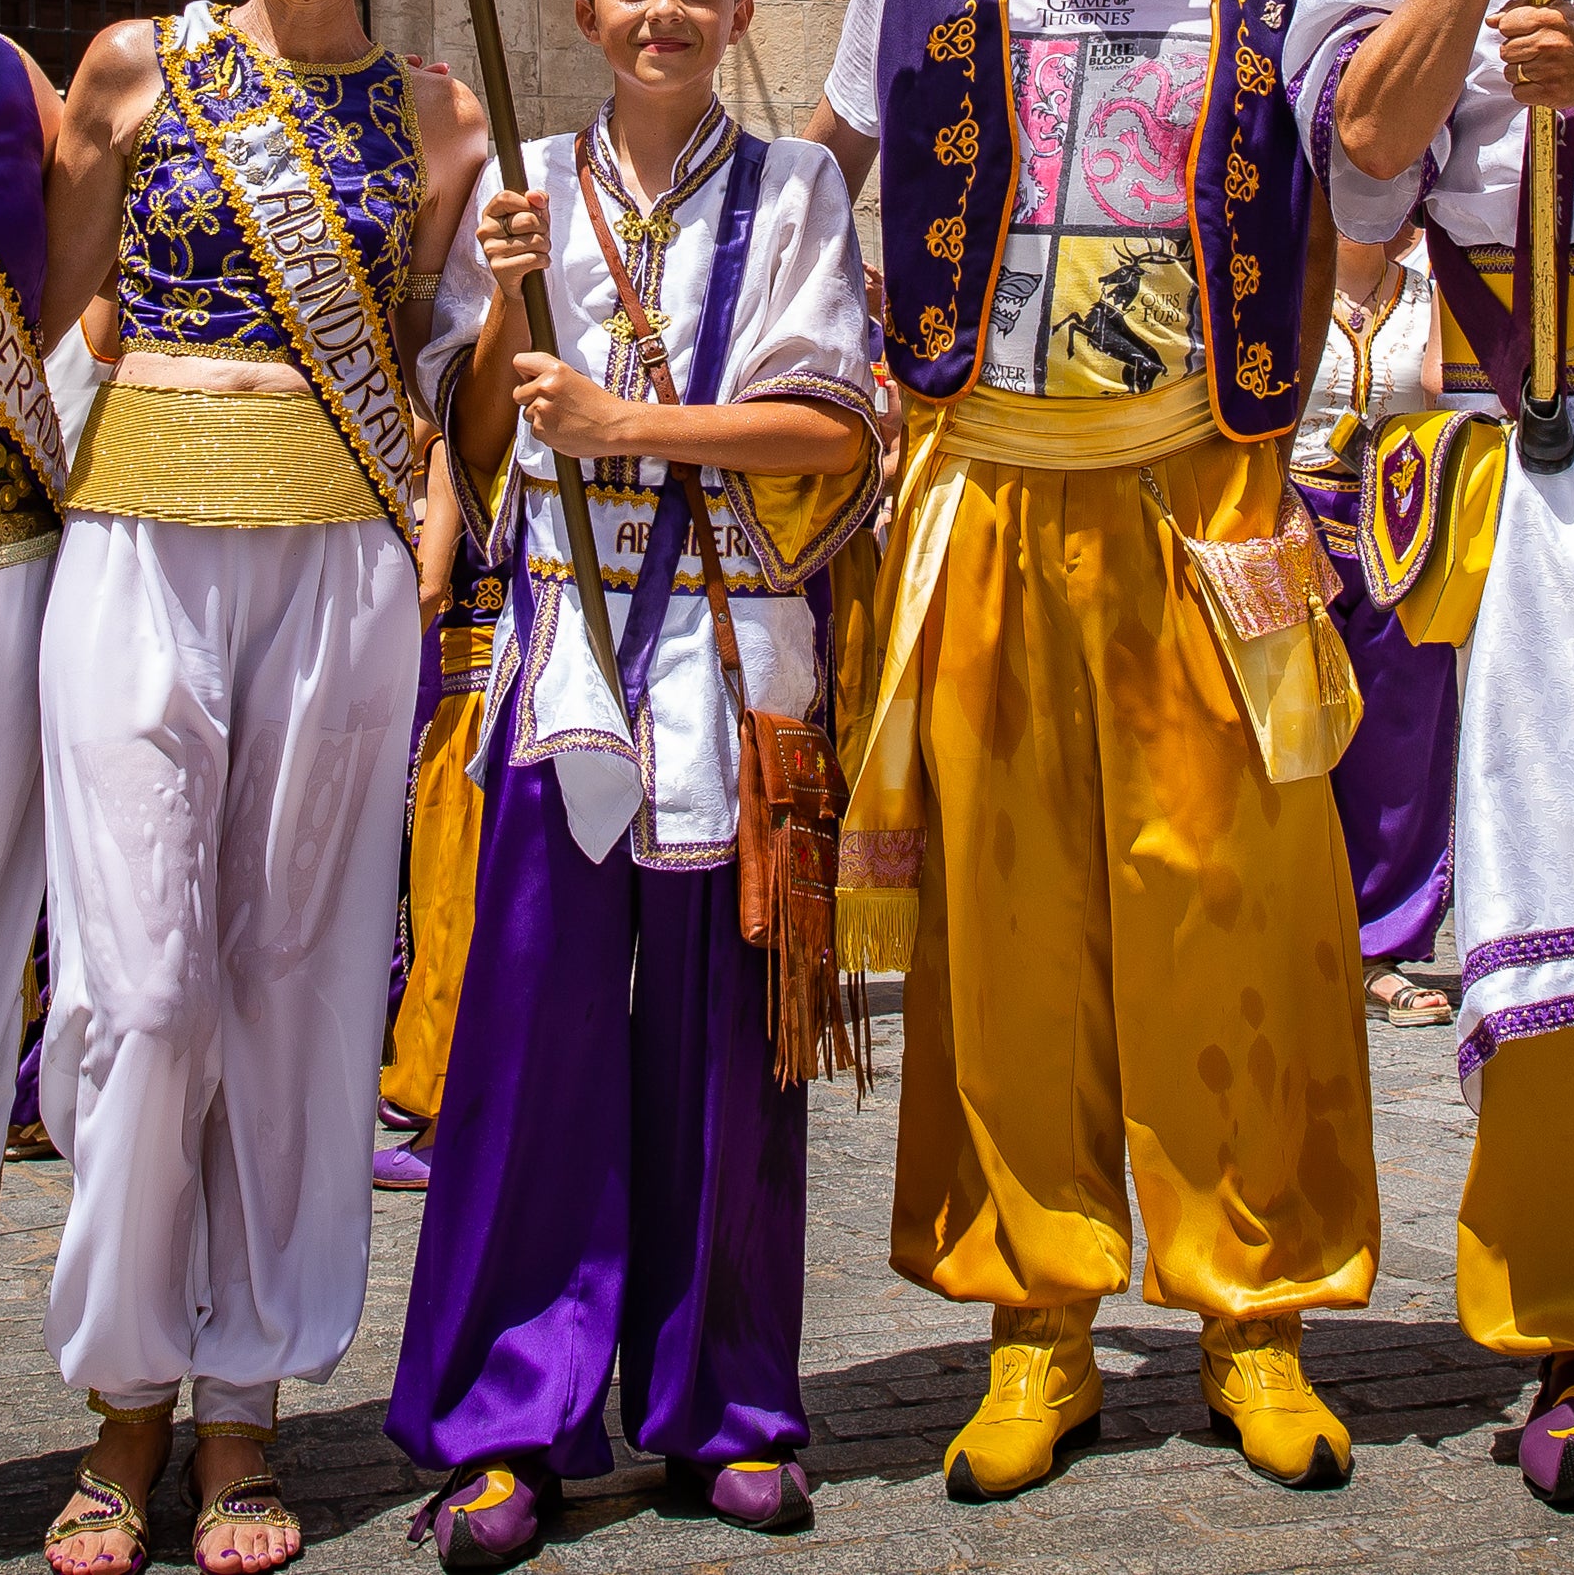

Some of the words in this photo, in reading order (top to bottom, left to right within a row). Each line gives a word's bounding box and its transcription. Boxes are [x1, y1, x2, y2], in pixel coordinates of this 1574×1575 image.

[1037, 8, 1131, 28] THRONES
[1091, 43, 1136, 57] FIRE
[1089, 56, 1135, 66] BLOOD
[1140, 292, 1180, 307] OURS
[1141, 307, 1182, 323] FURY
